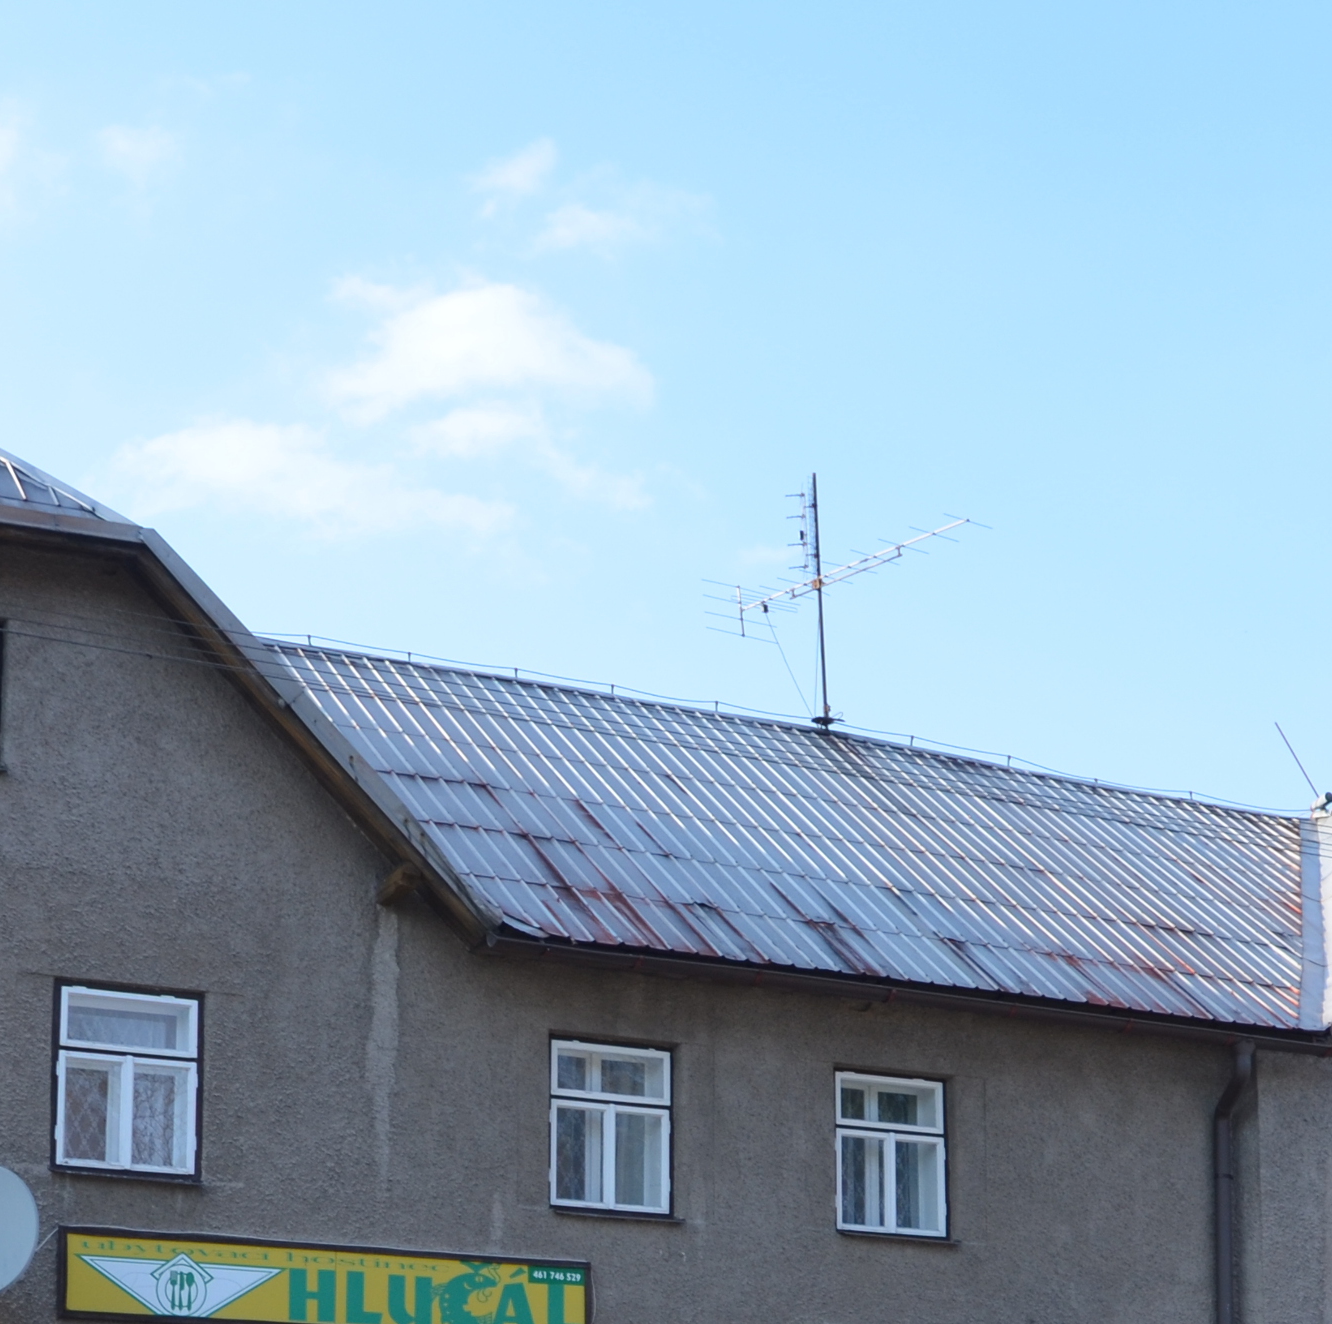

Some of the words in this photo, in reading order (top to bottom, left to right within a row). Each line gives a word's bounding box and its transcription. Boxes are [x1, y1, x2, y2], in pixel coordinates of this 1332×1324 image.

[286, 1251, 450, 1274] hostinec
[532, 1270, 547, 1280] 461
[550, 1271, 565, 1281] 746
[566, 1272, 582, 1282] 529
